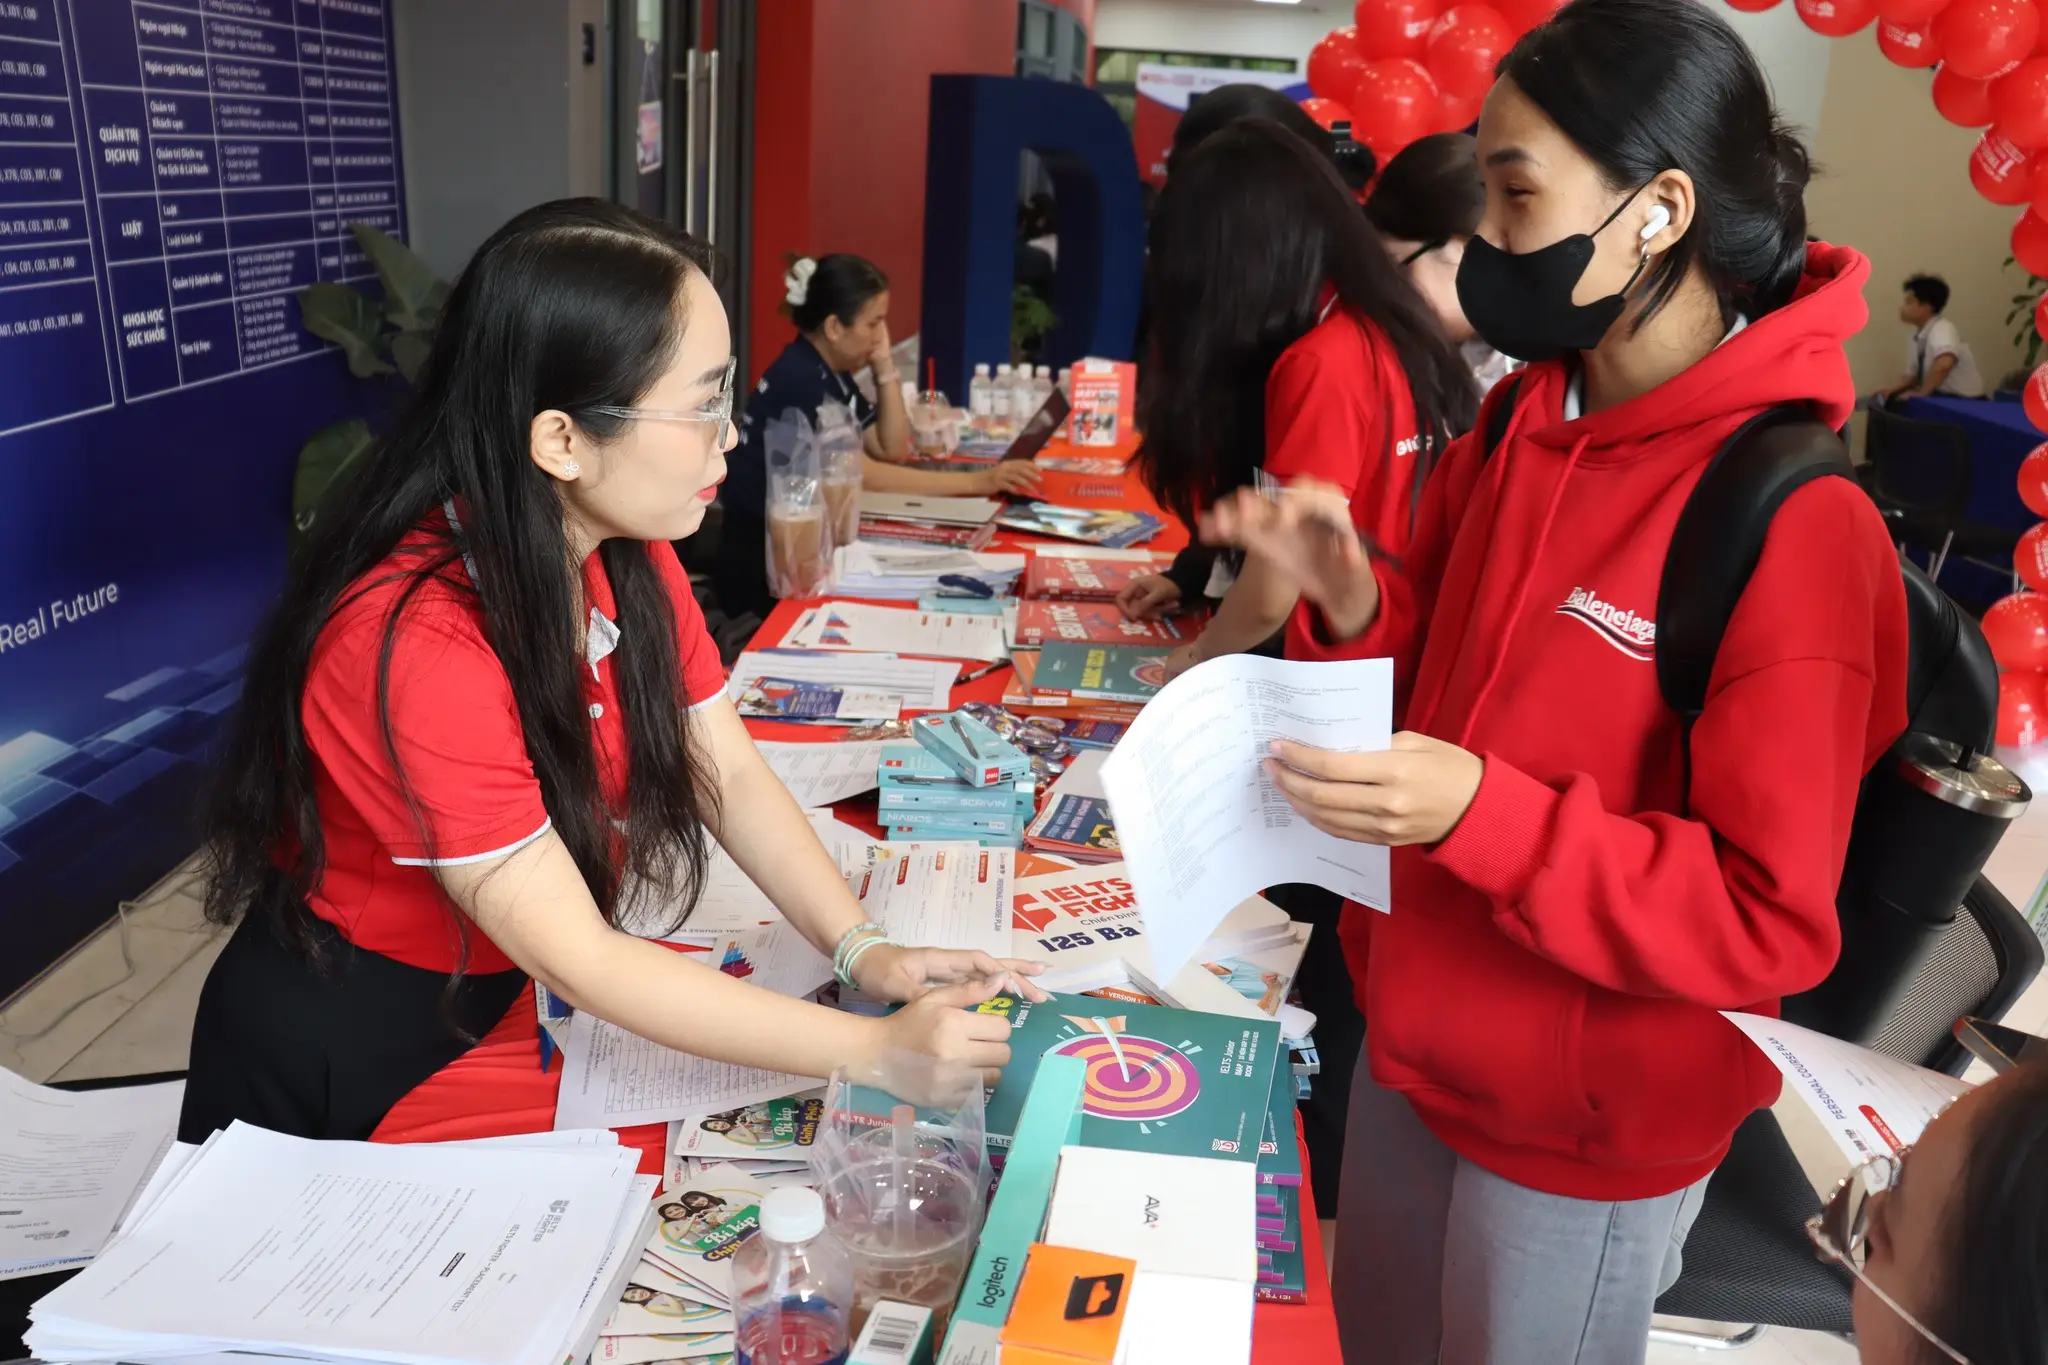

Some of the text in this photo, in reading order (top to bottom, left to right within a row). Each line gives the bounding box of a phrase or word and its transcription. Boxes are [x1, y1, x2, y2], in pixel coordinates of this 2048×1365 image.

[100, 124, 140, 144] QUẢN TRỊ
[105, 149, 139, 166] DỊCH VỤ
[122, 221, 142, 239] LUẬT
[123, 308, 164, 328] KHOA HỌC
[126, 328, 143, 348] SỨC
[0, 582, 118, 654] Real Future
[1564, 586, 1656, 641] Balenciaga
[960, 798, 1008, 808] SCRIVIN
[887, 814, 934, 824] SCRIVIN
[1040, 877, 1132, 903] IELTS
[1060, 892, 1138, 918] FIGH
[1080, 910, 1140, 926] Chiến binh
[1038, 922, 1142, 952] 125 Bà
[1108, 992, 1136, 1004] VERSION
[1010, 1010, 1030, 1028] Version
[1220, 1040, 1236, 1074] IELTS Junior
[1766, 1036, 1847, 1120] PERSONAL COURSE PLAN
[867, 1118, 894, 1128] Junio
[798, 1122, 816, 1145] Chinh
[986, 1136, 1012, 1146] IELTS
[506, 1224, 520, 1240] IELTS
[532, 1214, 554, 1243] FIGHTER
[490, 1238, 512, 1262] FIGHTER
[463, 1266, 491, 1298] PLACEMENT
[976, 1256, 1010, 1309] logitech
[450, 1299, 466, 1312] TEST
